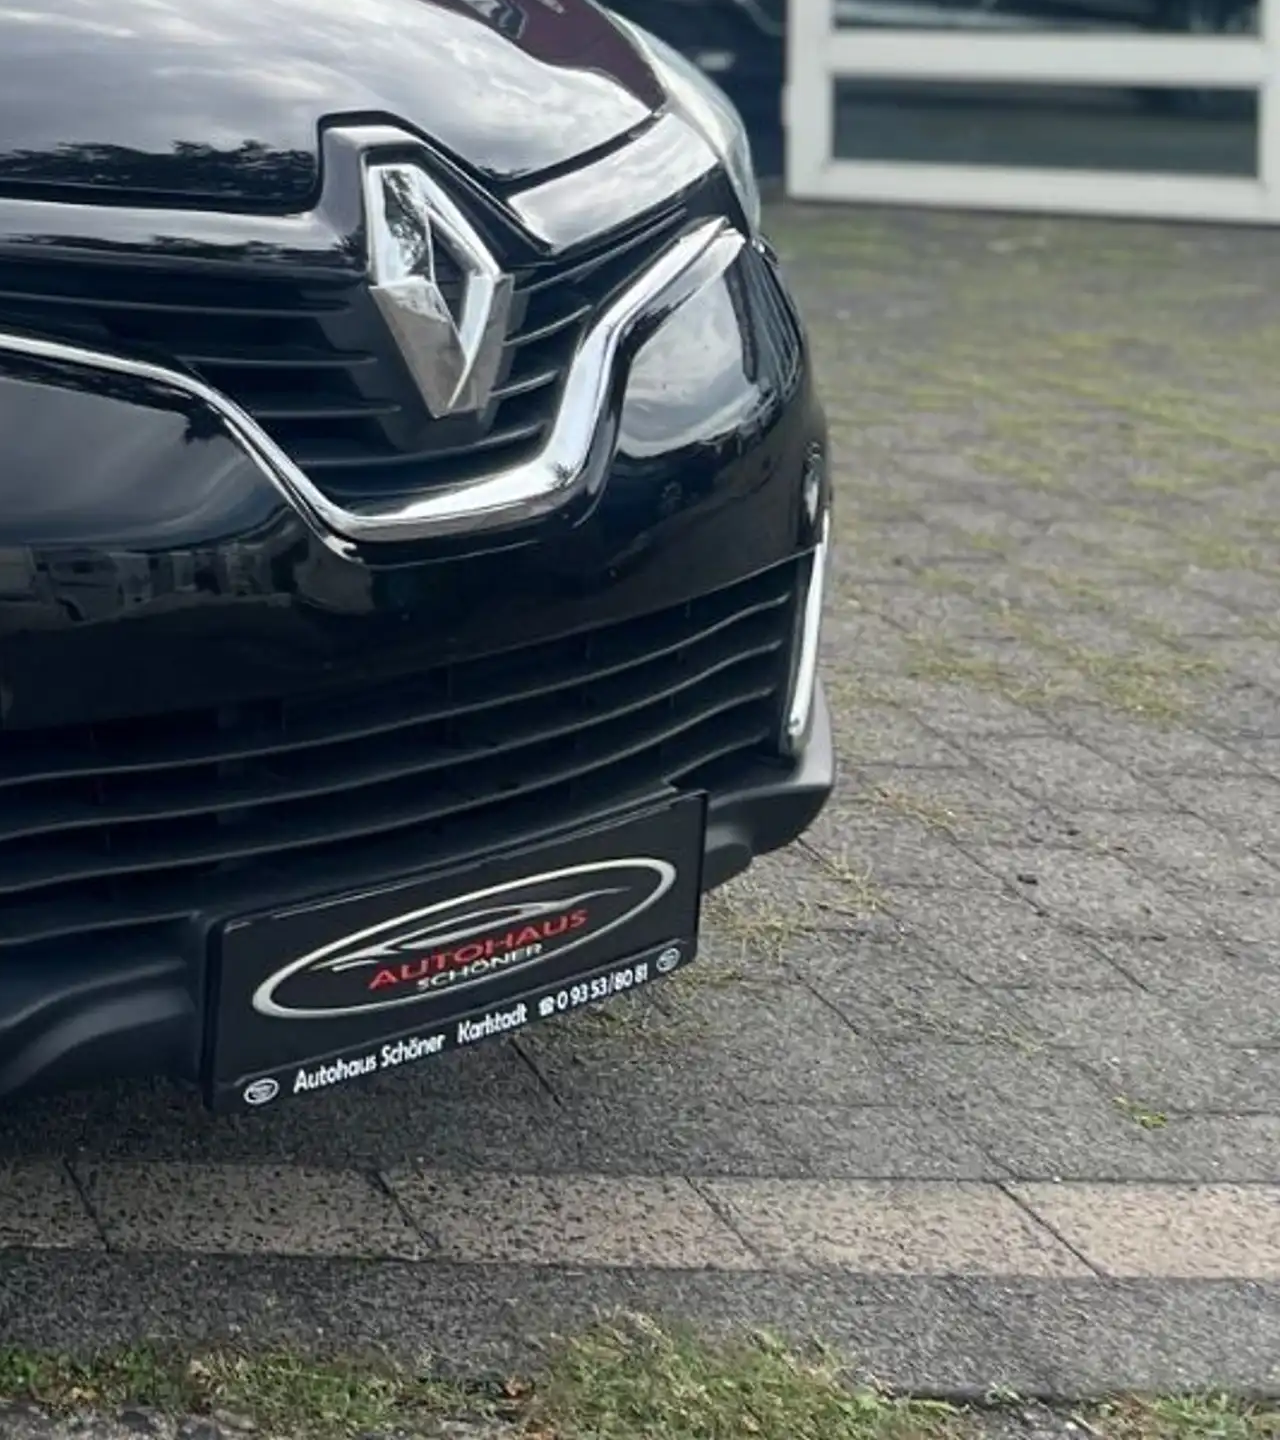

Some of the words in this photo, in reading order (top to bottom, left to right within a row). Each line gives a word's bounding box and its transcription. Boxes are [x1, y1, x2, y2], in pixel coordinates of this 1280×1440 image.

[368, 909, 588, 989] AUTOHAUS
[292, 1058, 377, 1094] Autohaus
[380, 1033, 446, 1069] Schöner
[456, 1003, 528, 1044] Karlstadt
